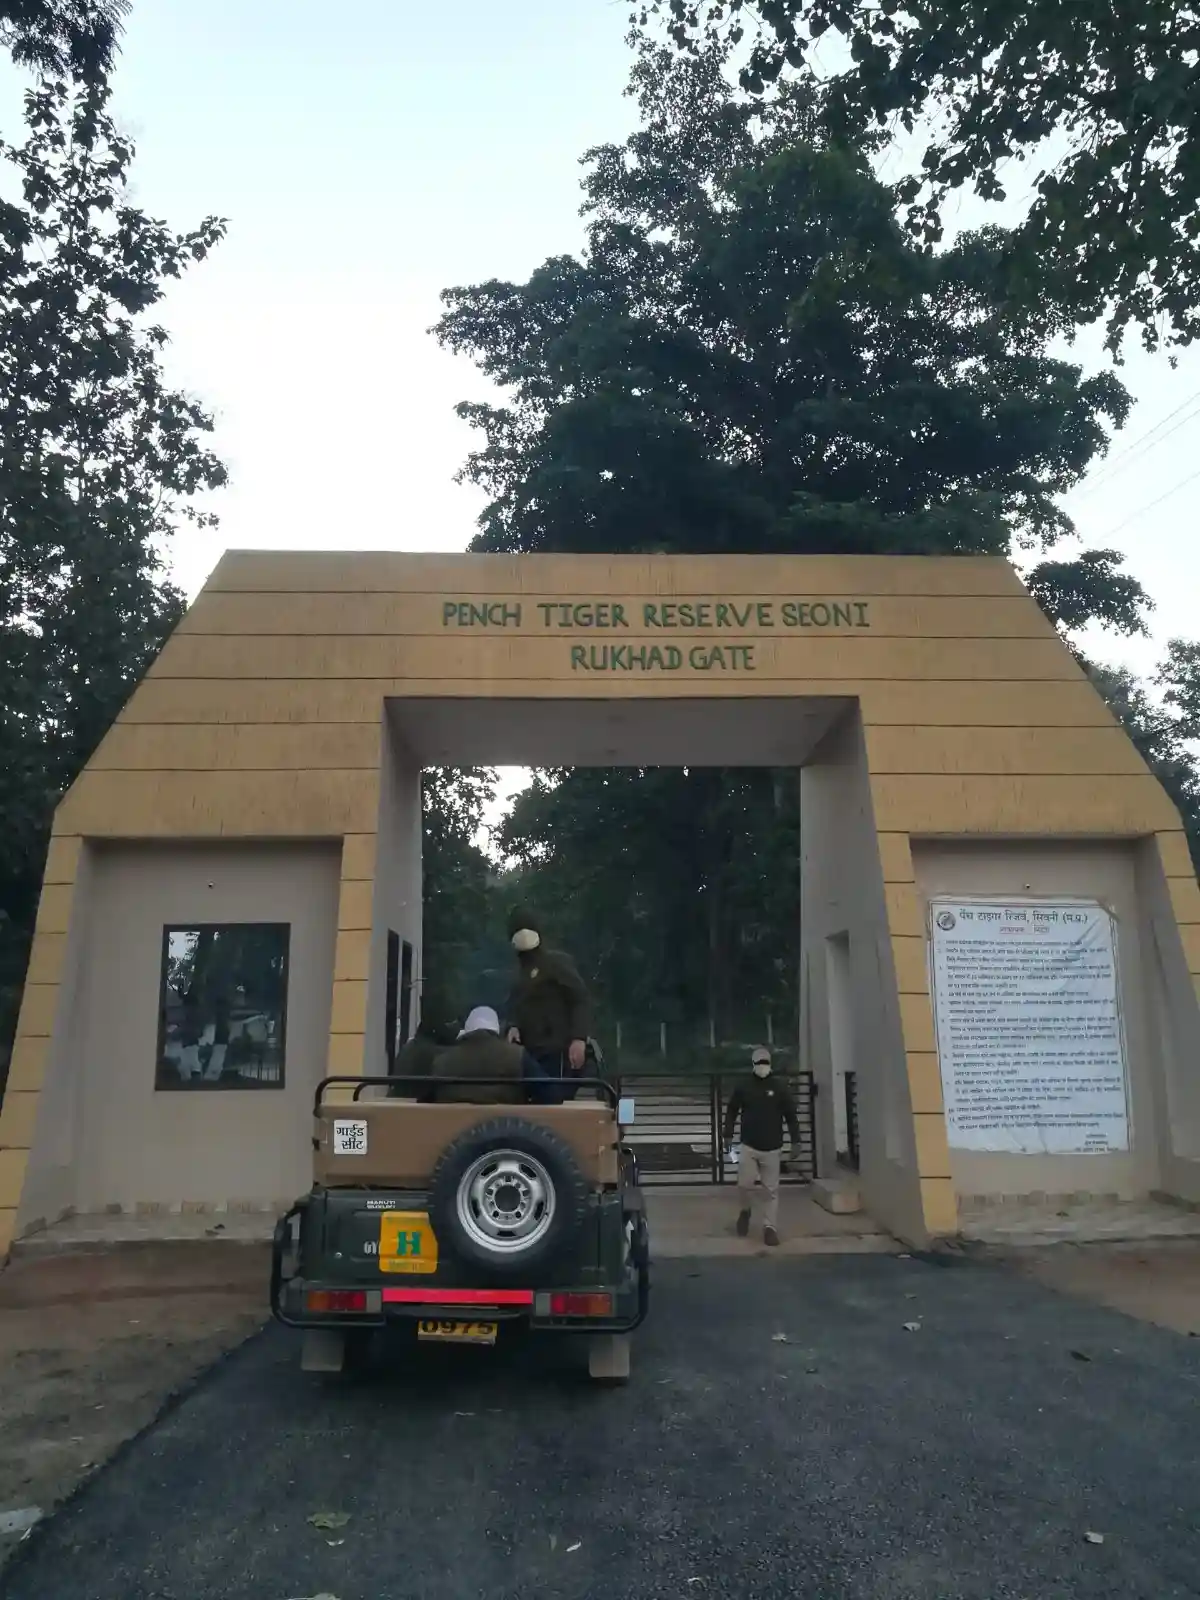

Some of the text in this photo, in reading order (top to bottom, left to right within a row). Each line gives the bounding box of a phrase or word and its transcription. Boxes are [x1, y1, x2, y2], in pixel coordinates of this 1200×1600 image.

[443, 602, 870, 629] PENCH TIGER RESERVE SEONI
[570, 644, 756, 671] RUKHAD GATE
[336, 1124, 364, 1137] गाईड
[341, 1137, 364, 1150] सीट
[397, 1231, 421, 1256] H
